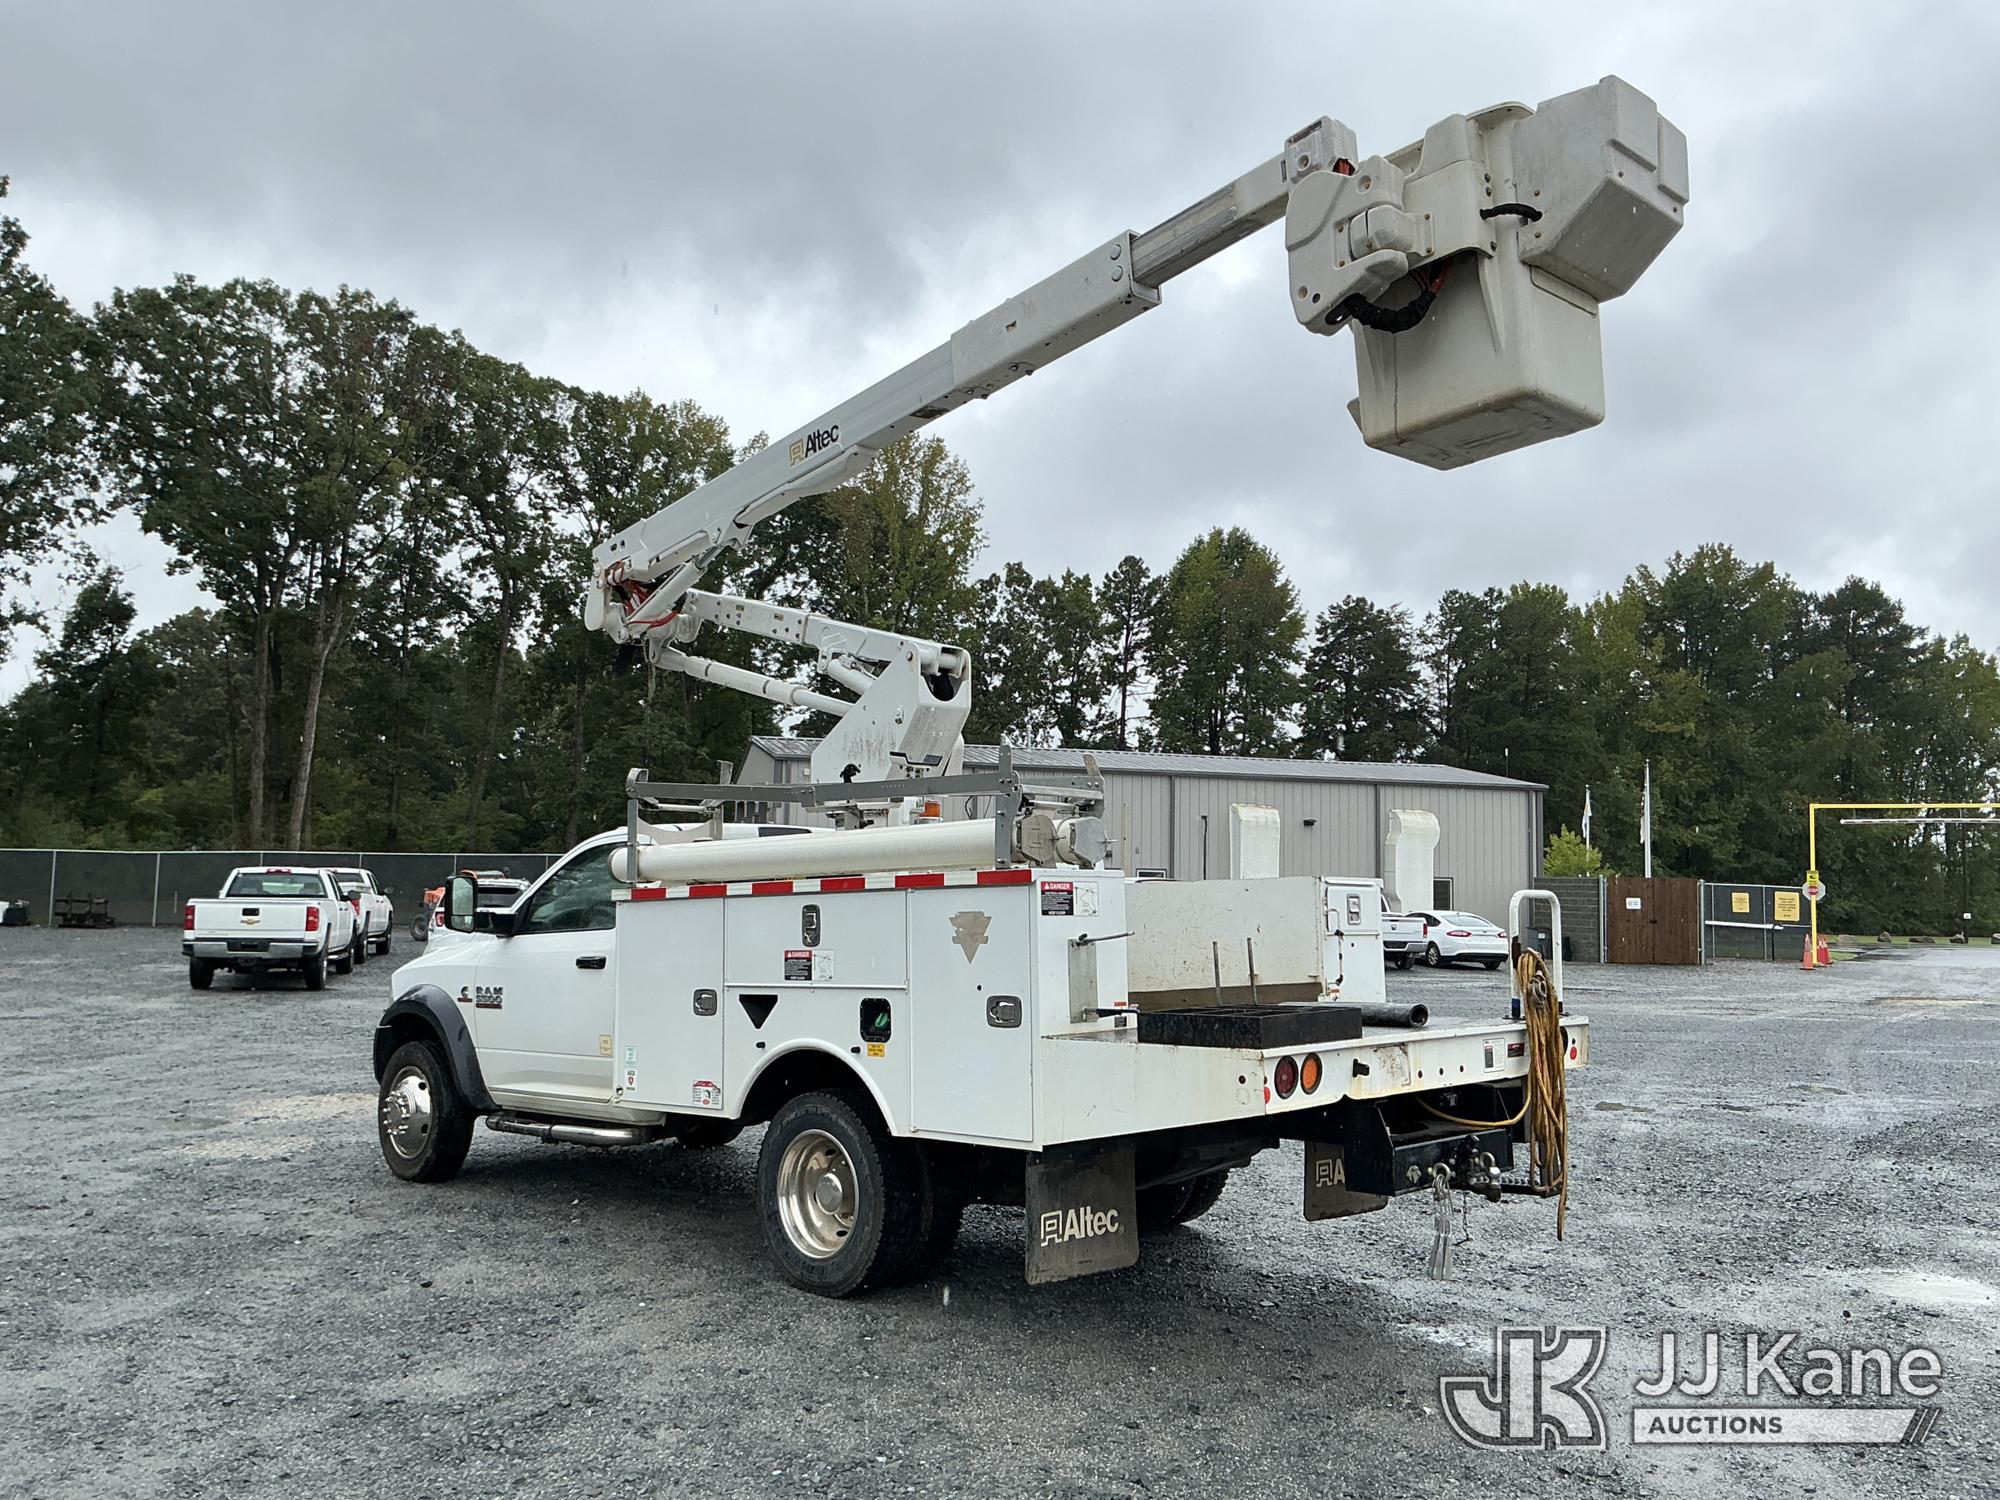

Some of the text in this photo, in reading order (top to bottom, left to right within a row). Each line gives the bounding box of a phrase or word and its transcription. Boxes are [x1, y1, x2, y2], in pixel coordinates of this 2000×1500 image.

[805, 425, 839, 458] Altec
[1050, 882, 1070, 890] DANGER
[476, 986, 503, 995] RAM
[1064, 1206, 1119, 1241] Altec
